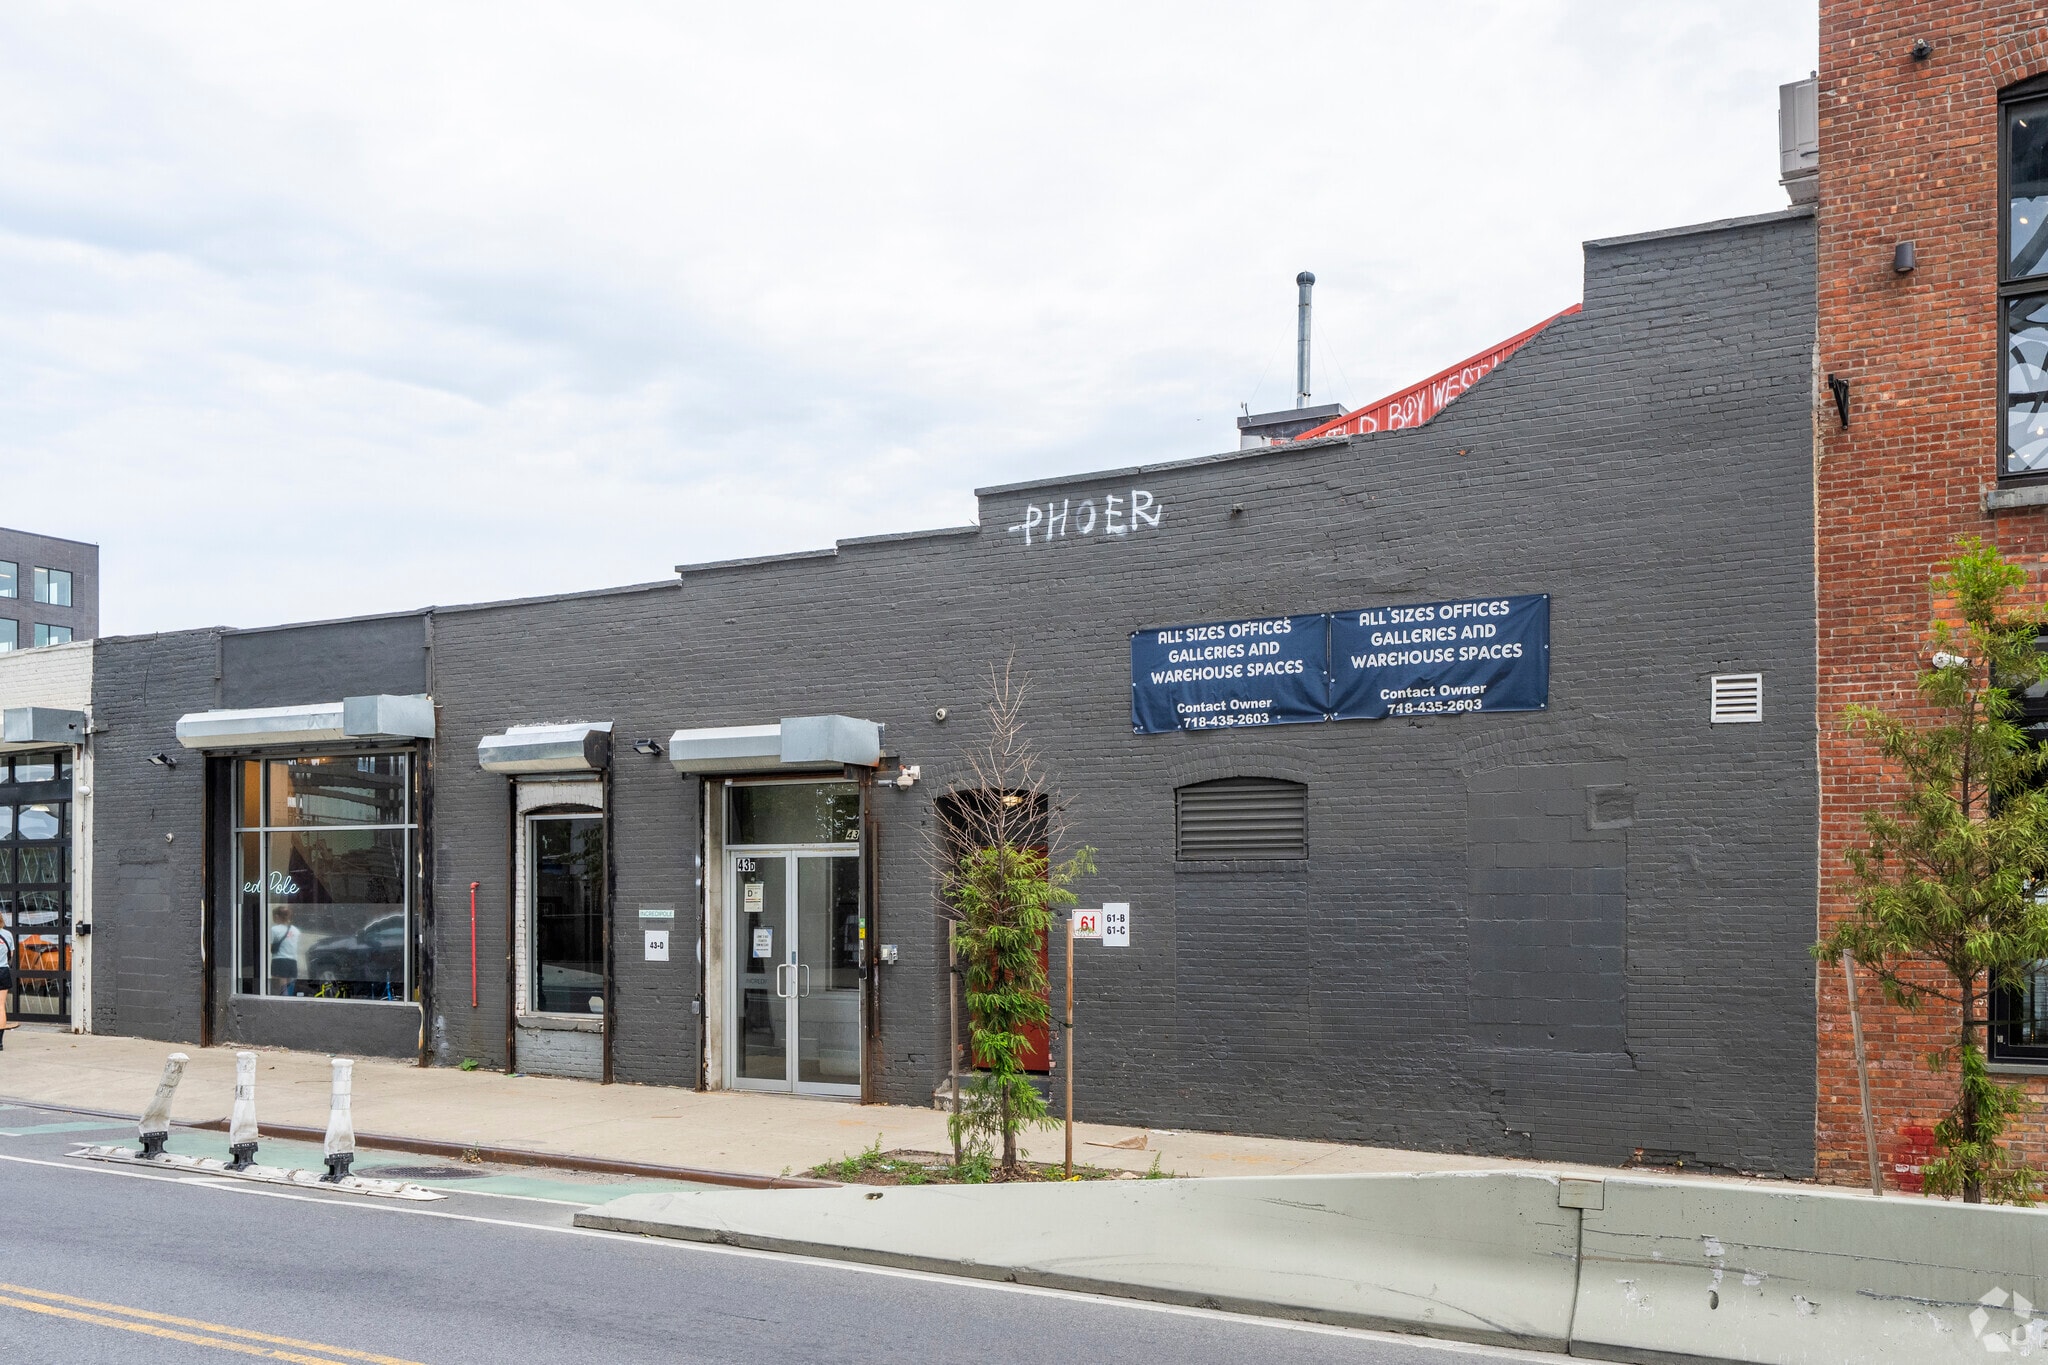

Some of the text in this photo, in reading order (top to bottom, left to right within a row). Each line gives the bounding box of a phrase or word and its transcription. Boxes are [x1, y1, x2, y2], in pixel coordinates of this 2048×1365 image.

[1389, 390, 1426, 430] BOY
[1358, 600, 1510, 627] ALL SIZES OFFICES
[1158, 619, 1292, 645] ALL SIZES OFFICES
[1370, 623, 1497, 647] GALLERIES AND
[1168, 641, 1281, 664] GALLERIES AND
[1350, 642, 1523, 669] WAREHOUSE SPACES
[1150, 659, 1304, 685] WAREHOUSE SPACES
[1379, 683, 1487, 700] Contact Owner
[1177, 699, 1273, 714] Contact Owner
[1386, 698, 1483, 715] 718-435-2603
[1183, 712, 1270, 729] 718-435-2603
[1081, 915, 1095, 931] 61
[1106, 914, 1125, 922] 61-B
[1106, 926, 1125, 935] 61-C
[649, 941, 664, 950] 43-D
